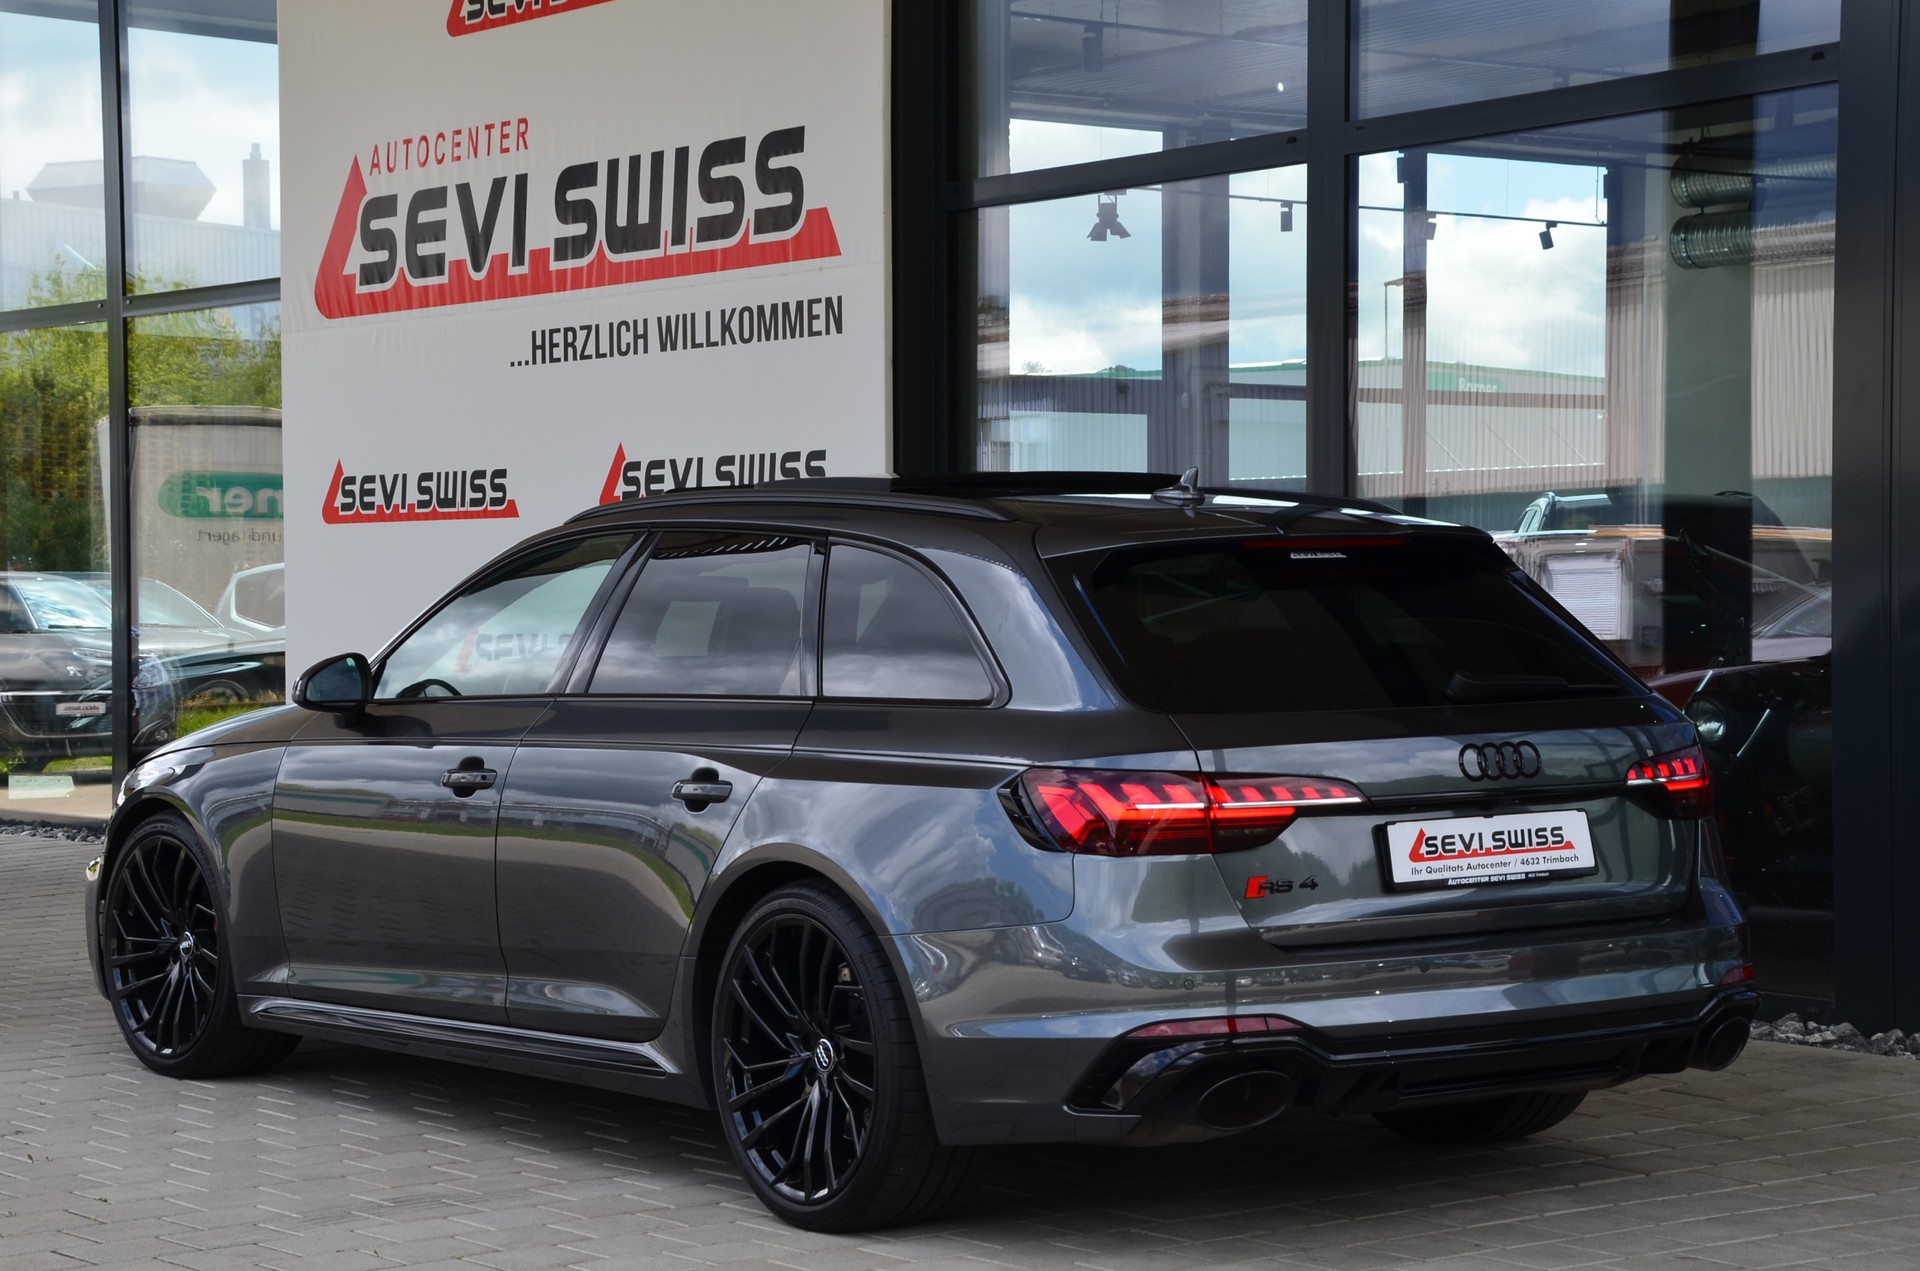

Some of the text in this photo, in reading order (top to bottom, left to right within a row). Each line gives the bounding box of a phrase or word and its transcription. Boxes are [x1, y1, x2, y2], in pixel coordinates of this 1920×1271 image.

[370, 117, 529, 175] AUTOCENTER
[359, 126, 806, 287] SEVI SWISS
[510, 296, 843, 368] ...HERZLICH WILLKOMMEN
[340, 469, 508, 512] SEVI SWISS
[622, 449, 826, 500] SEVI SWISS
[1424, 826, 1565, 856] SEVI SWISS
[1250, 875, 1319, 897] RS 4
[1411, 867, 1423, 876] Ihr
[1425, 863, 1464, 875] Qualitats
[1466, 860, 1511, 871] Autocenter
[1520, 857, 1541, 866] 4632
[1543, 854, 1579, 865] Trimbach
[1490, 874, 1505, 882] SEVI
[1506, 873, 1526, 881] SWISS
